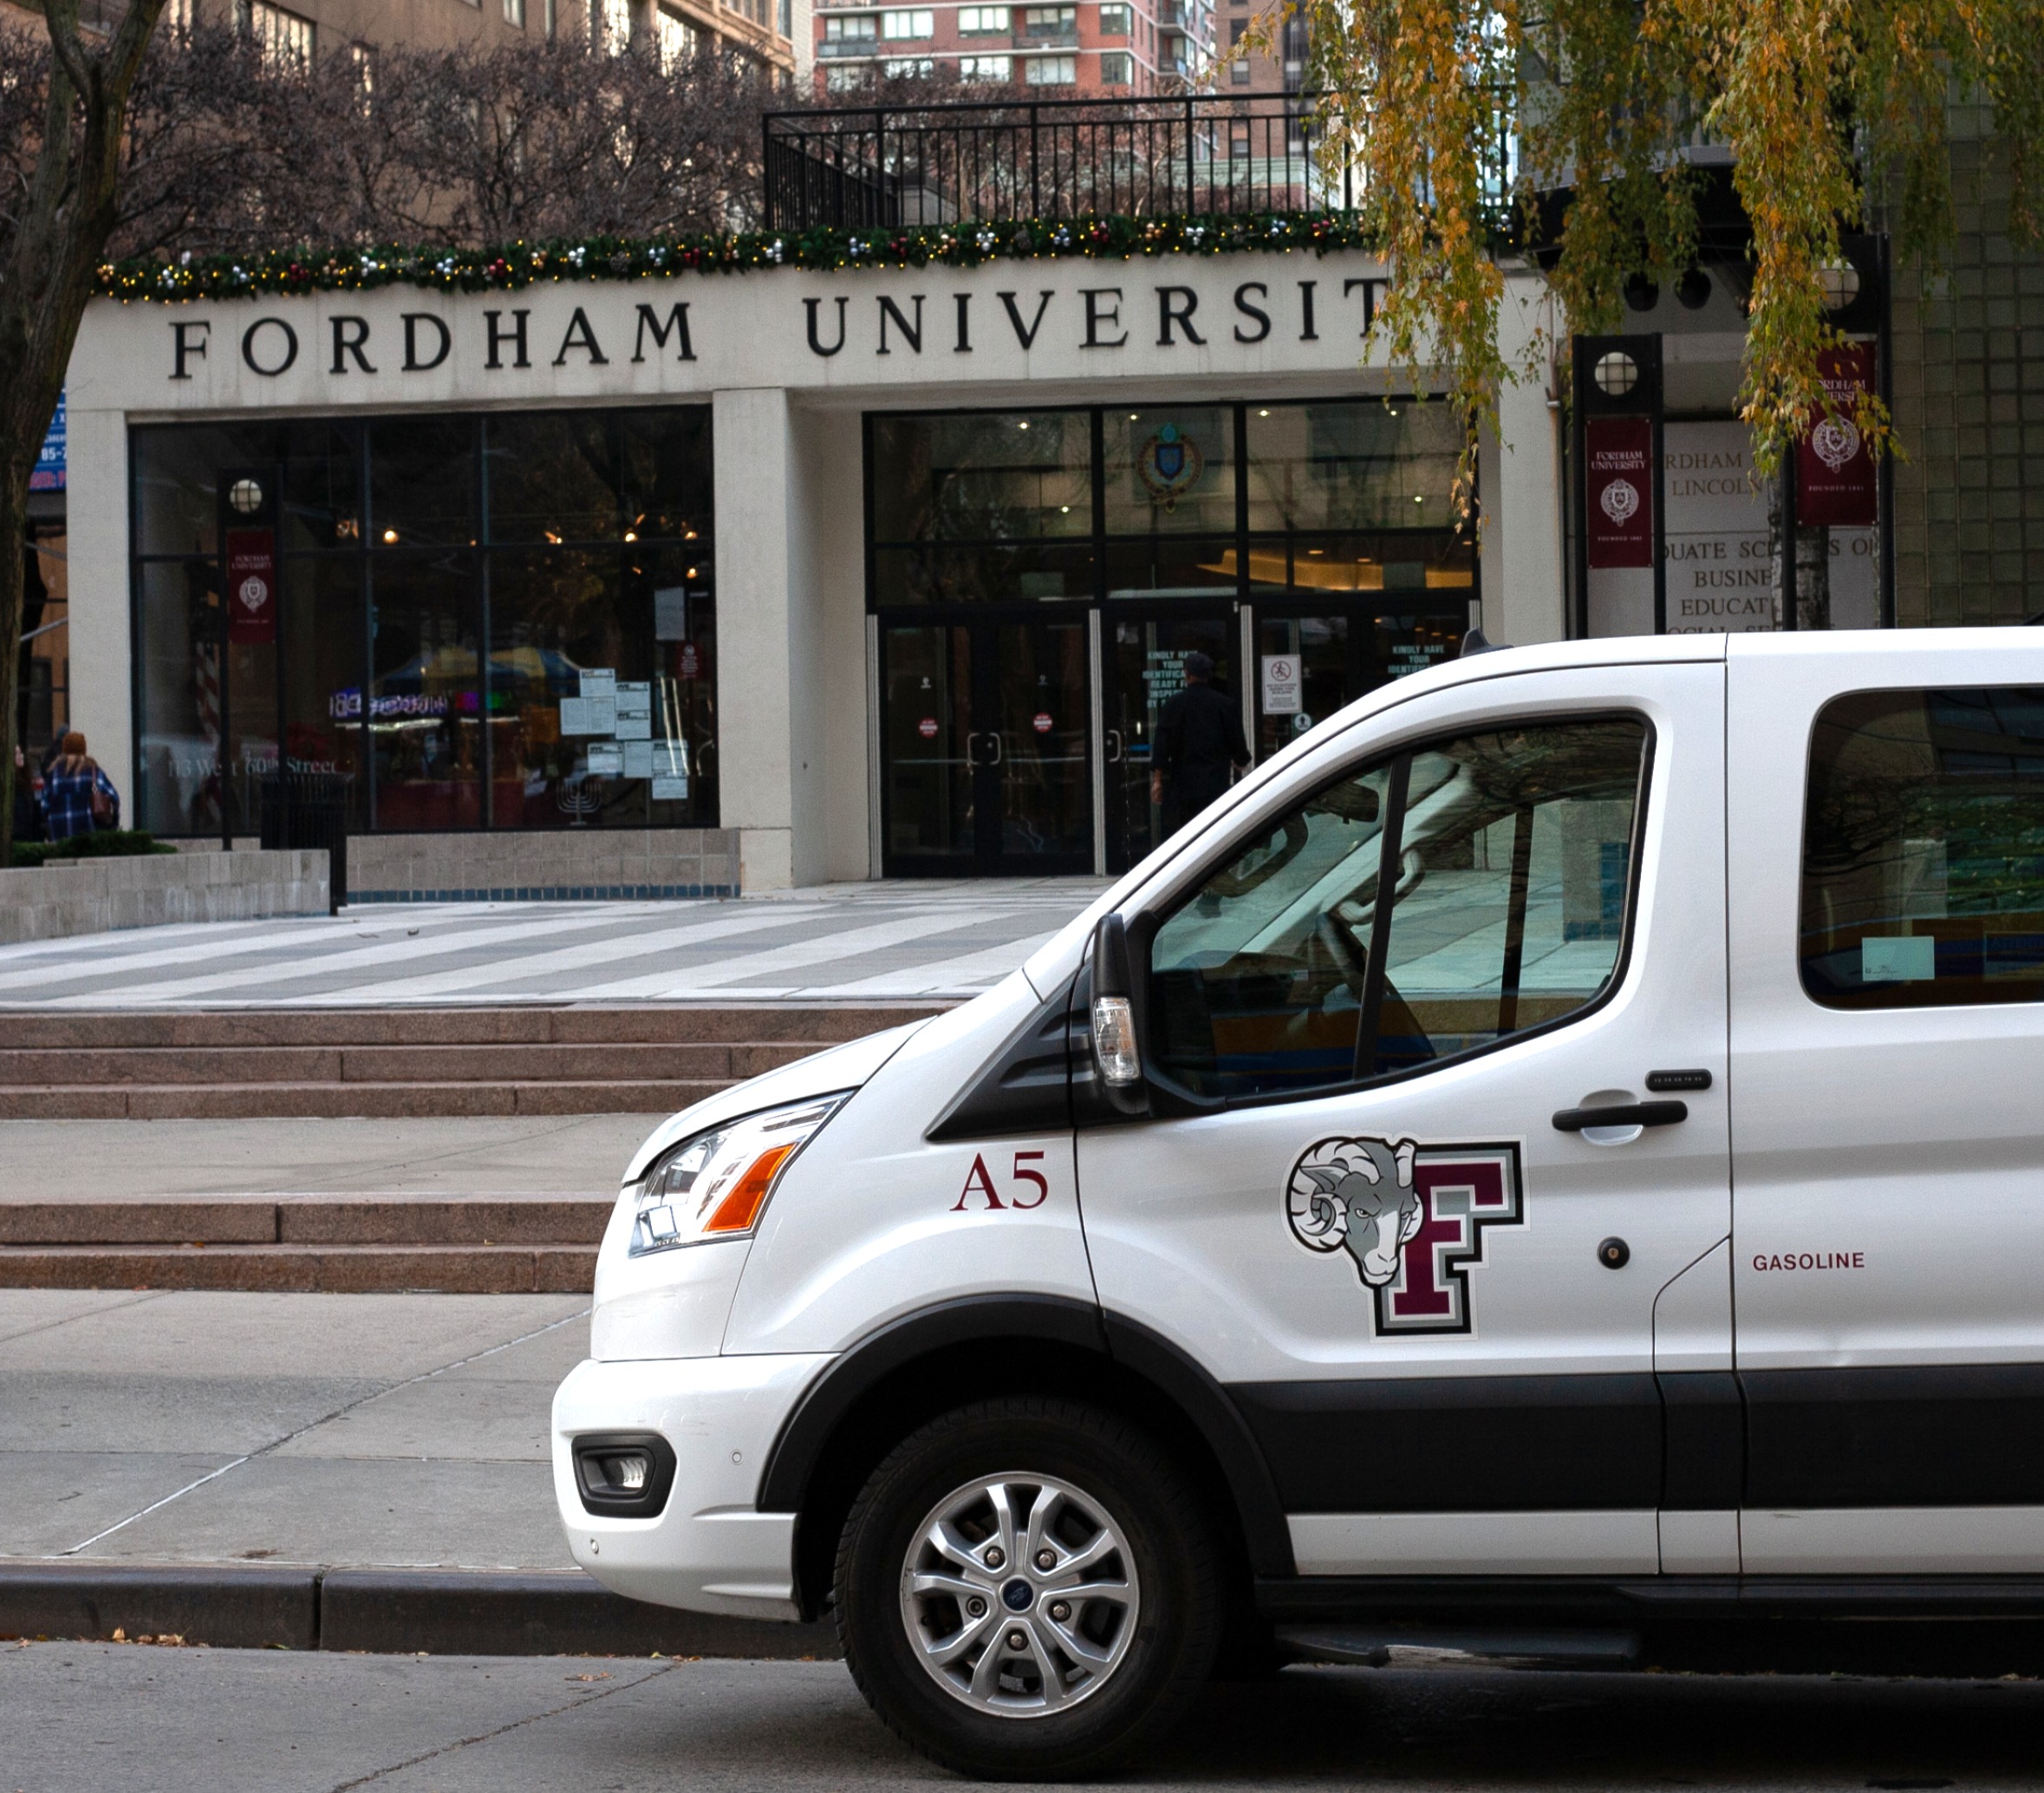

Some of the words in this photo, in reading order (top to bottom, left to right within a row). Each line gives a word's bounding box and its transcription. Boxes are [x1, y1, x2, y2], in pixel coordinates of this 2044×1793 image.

[169, 303, 697, 380] FORDHAM
[802, 277, 1392, 357] UNIVERSIT
[1597, 451, 1643, 460] FORDHAM
[1666, 452, 1742, 469] RDHAM
[1591, 460, 1646, 470] UNIVERSITY
[1695, 570, 1771, 588] BUSINE
[1681, 598, 1768, 616] EDUCAT
[1148, 650, 1175, 659] KINDLY
[1393, 645, 1420, 654] KINDLY
[1423, 645, 1444, 654] HAVE
[1162, 660, 1183, 668] YOUR
[1409, 655, 1429, 664] YOUR
[1142, 669, 1187, 679] IDENTIFICA
[197, 758, 238, 778] Wet
[287, 756, 337, 774] Street
[949, 1151, 1048, 1211] A5
[1753, 1252, 1865, 1271] GASOLINE
